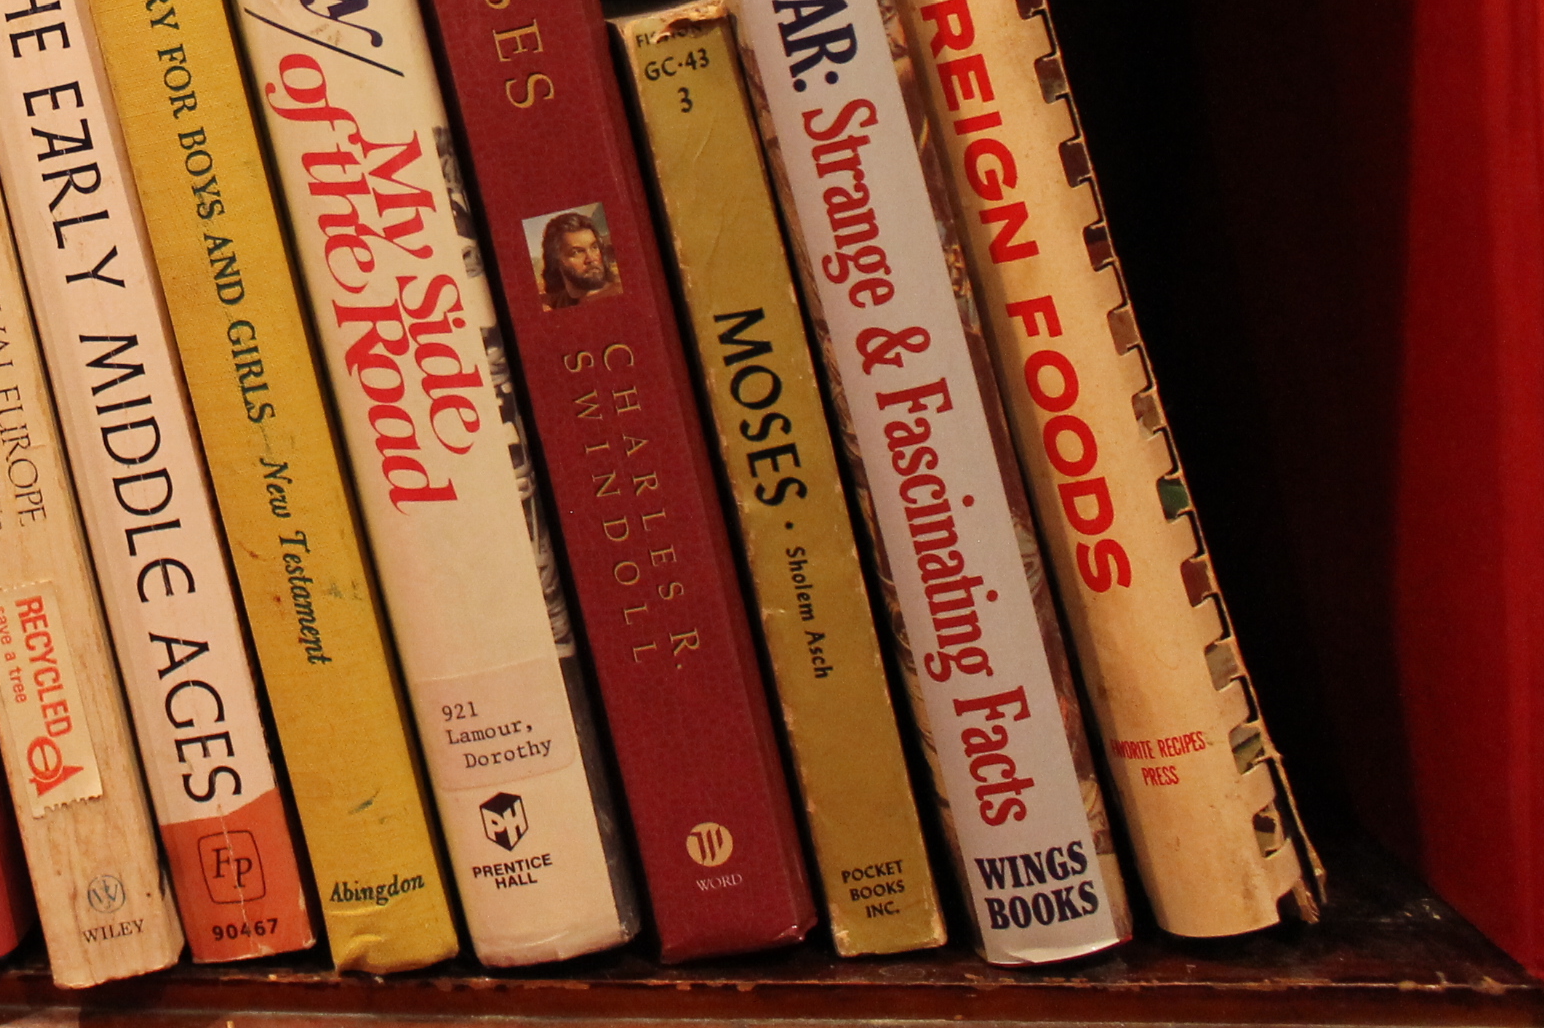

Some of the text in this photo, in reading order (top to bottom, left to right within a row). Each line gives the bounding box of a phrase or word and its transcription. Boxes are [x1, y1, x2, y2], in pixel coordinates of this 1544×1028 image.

[156, 42, 199, 120] FOR
[677, 86, 694, 114] 3
[177, 126, 227, 222] BOYS
[801, 97, 896, 310] Strange
[203, 232, 247, 308] AND
[264, 52, 459, 518] of the Road
[352, 129, 487, 457] My Side
[225, 318, 278, 426] GIRLS
[854, 325, 931, 376] &
[22, 80, 126, 290] EARLY
[78, 333, 197, 605] MIDDLE
[148, 631, 244, 807] AGES
[1003, 294, 1134, 596] FOODS
[258, 456, 293, 521] New
[563, 350, 657, 666] SWINDOLL
[601, 341, 702, 671] CHARLES R.
[713, 307, 834, 680] MOSES Sholem Asch
[874, 376, 999, 683] Fascinating
[277, 530, 333, 667] Testament
[4, 651, 17, 664] a
[14, 594, 75, 739] RECYCLED
[5, 663, 29, 705] tree
[441, 700, 479, 720] 921
[445, 718, 534, 747] Lamour,
[462, 737, 554, 771] Dorothy
[952, 684, 1036, 829] Facts
[1157, 729, 1207, 759] RECIPES
[1140, 764, 1181, 787] PRESS
[329, 873, 426, 907] Abingdon
[472, 853, 554, 880] PRENTICE
[494, 872, 539, 891] HALL
[696, 872, 744, 894] WORD
[841, 859, 904, 884] POCKET
[974, 839, 1090, 890] WINGS
[849, 880, 906, 903] BOOKS
[864, 898, 901, 919] INC.
[983, 880, 1100, 931] BOOKS
[82, 918, 146, 945] WILEY
[211, 918, 279, 943] 90467
